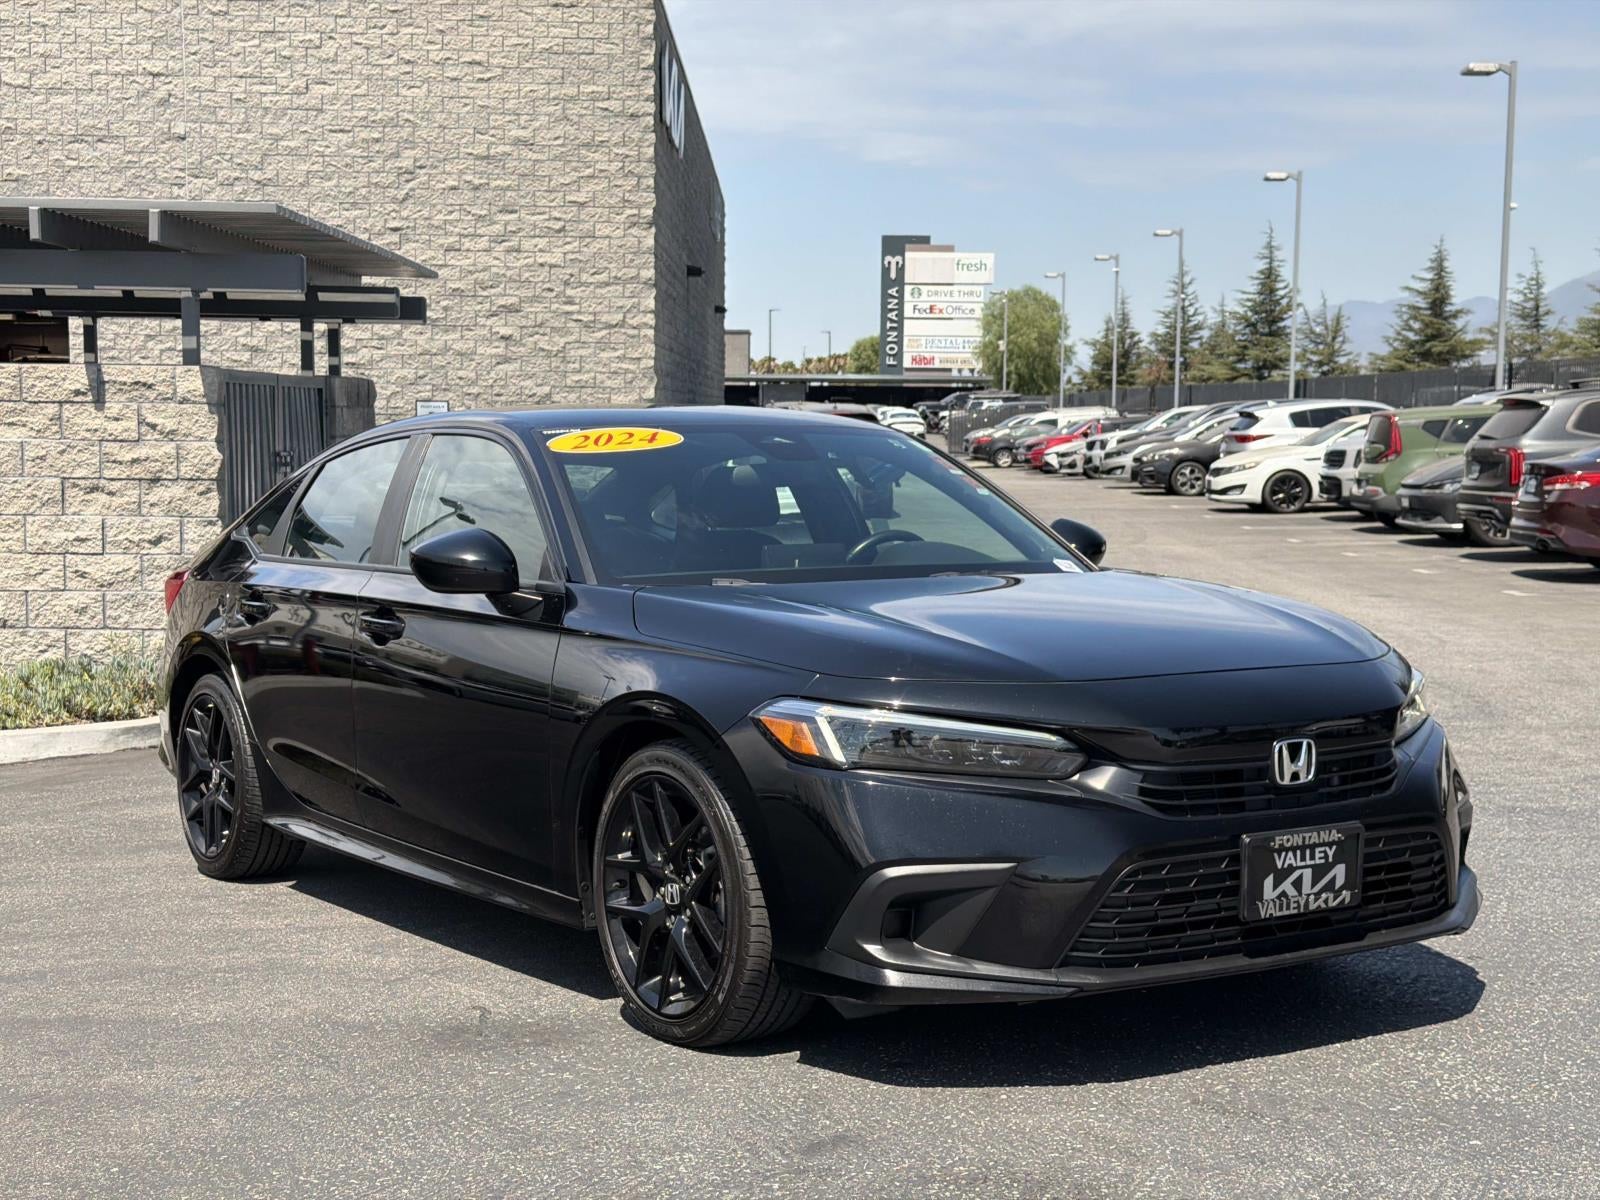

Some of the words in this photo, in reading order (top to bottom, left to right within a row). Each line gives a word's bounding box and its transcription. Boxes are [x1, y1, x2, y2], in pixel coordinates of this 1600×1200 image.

[956, 259, 988, 272] fresh
[926, 289, 955, 298] DRIVE
[957, 289, 982, 298] THRU
[912, 304, 945, 315] FedEx
[945, 304, 976, 315] Office
[885, 286, 899, 366] FONTANA
[571, 431, 660, 450] 2024
[1273, 845, 1337, 869] VALLEY
[1256, 895, 1307, 919] VALLEY
